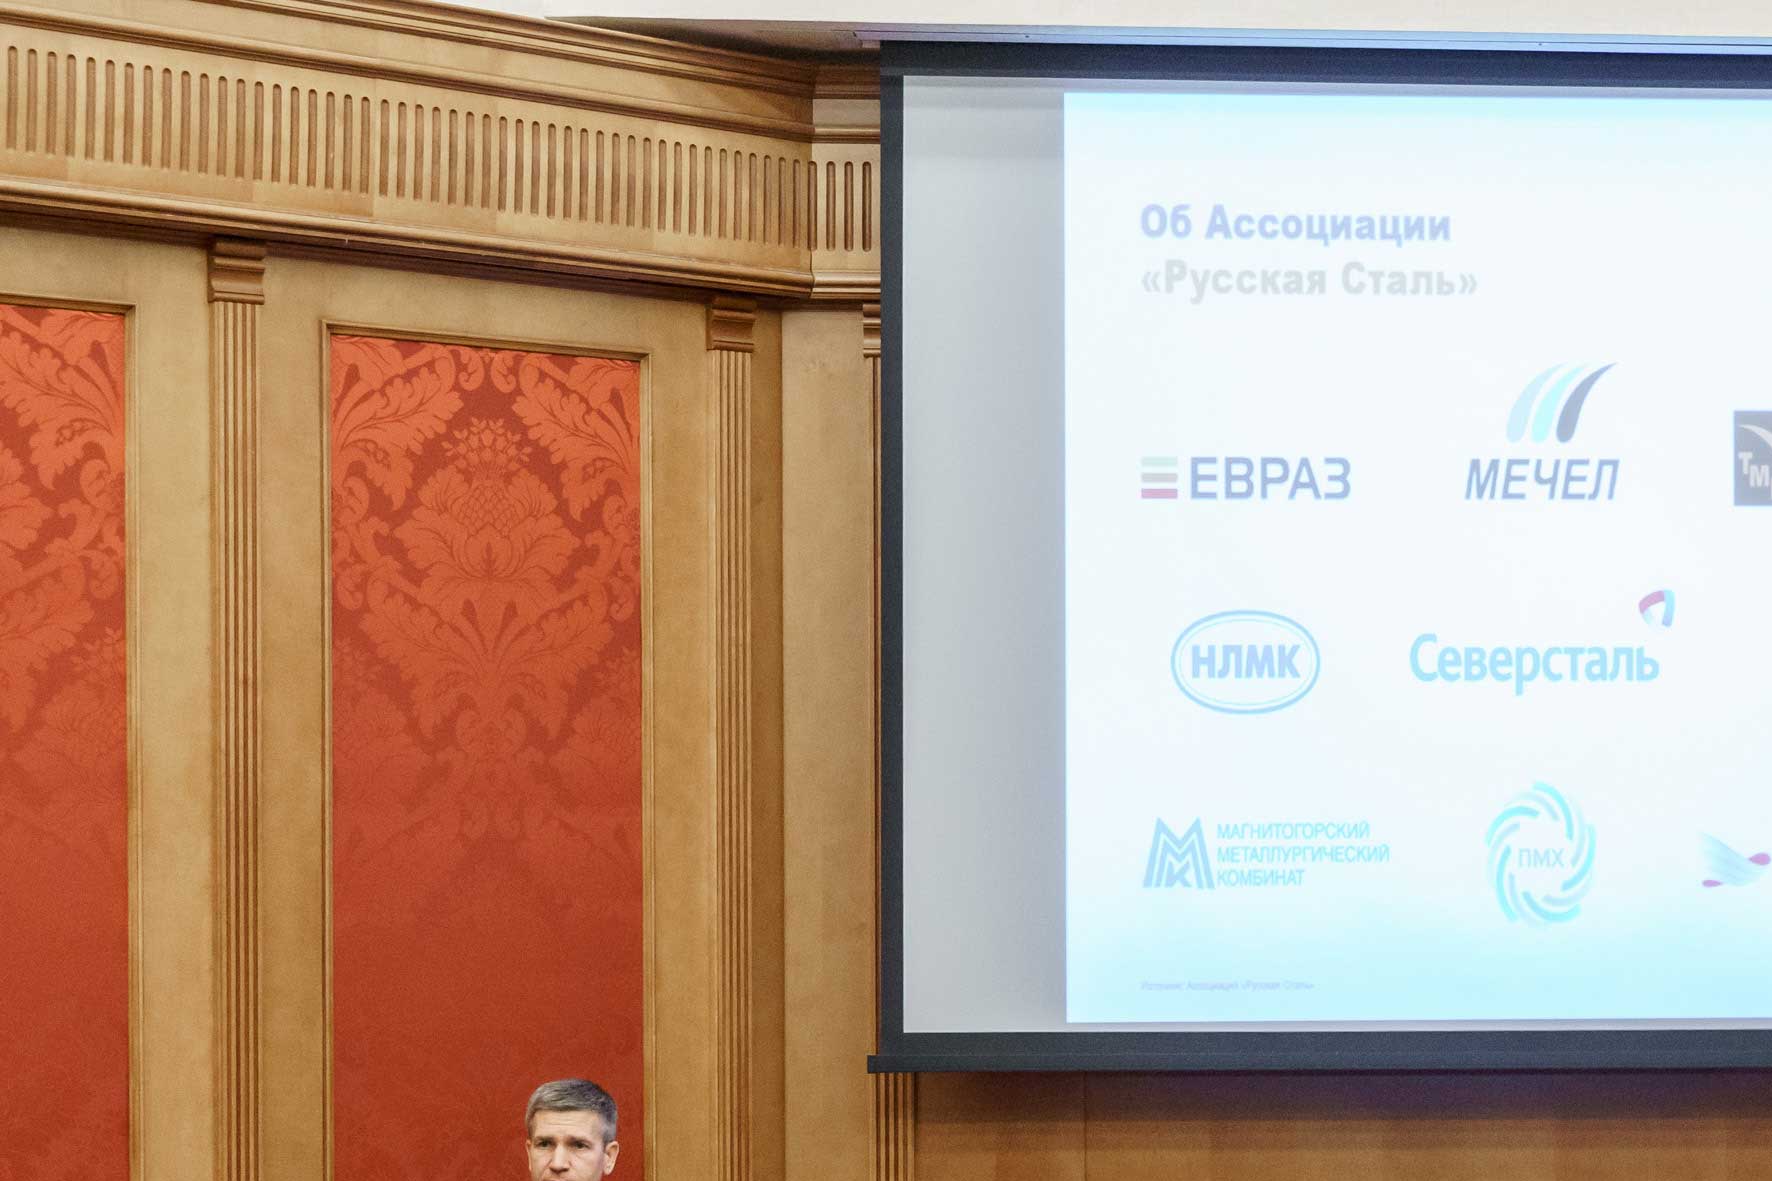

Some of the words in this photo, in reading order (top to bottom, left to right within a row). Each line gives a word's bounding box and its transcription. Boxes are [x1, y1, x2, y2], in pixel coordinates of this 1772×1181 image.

[1140, 203, 1192, 239] Об
[1205, 204, 1451, 247] Ассоциации
[1141, 259, 1327, 304] «Русская
[1341, 261, 1478, 297] Сталь»
[1190, 456, 1352, 500] ЕВРАЗ
[1464, 457, 1620, 501] МЕЧЕЛ
[1191, 644, 1301, 680] НЛМК
[1409, 633, 1660, 696] Северсталь
[1216, 821, 1371, 840] МАГНИТОГОРСКИЙ
[1216, 844, 1390, 863] МЕТАЛЛУРГИЧЕСКИЙ
[1518, 847, 1565, 868] ПМХ
[1216, 869, 1305, 887] КОМБИНАТ
